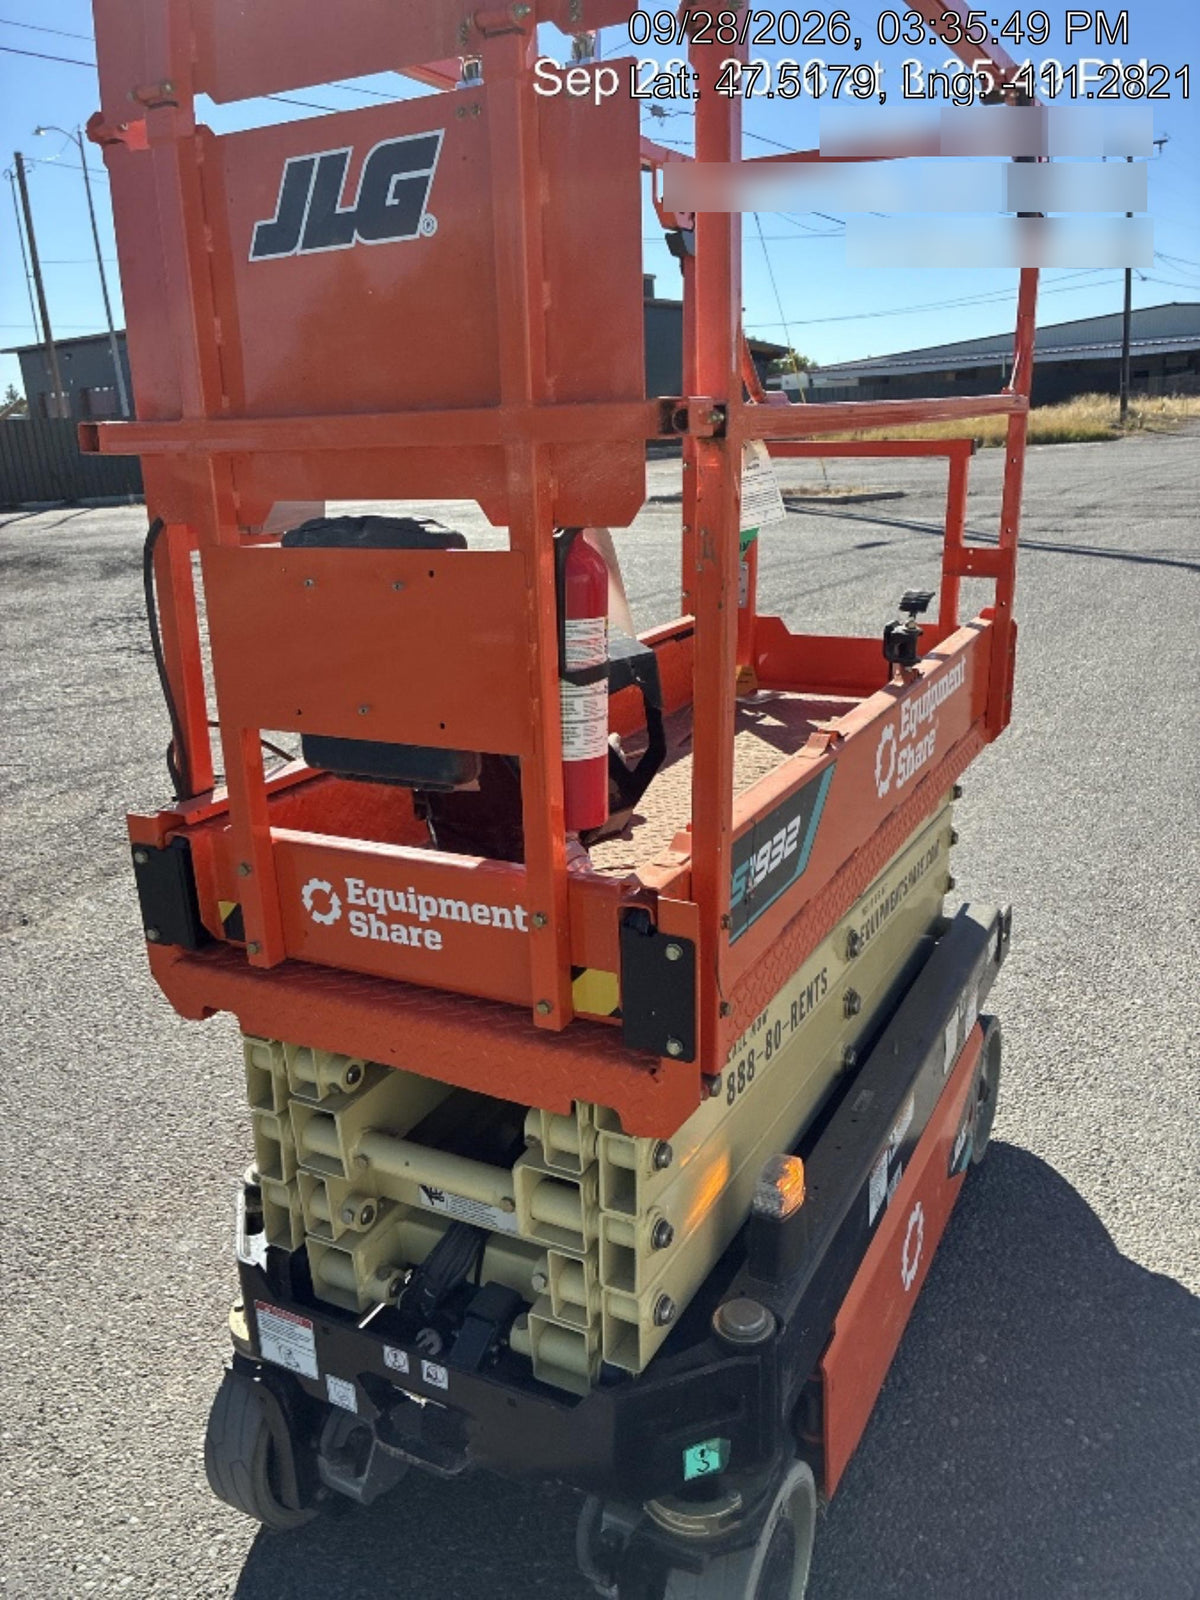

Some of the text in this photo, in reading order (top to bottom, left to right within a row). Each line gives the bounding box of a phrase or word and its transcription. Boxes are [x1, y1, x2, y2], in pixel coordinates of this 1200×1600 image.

[248, 128, 445, 262] JLG
[900, 655, 967, 742] Equipment
[896, 727, 937, 789] Share
[344, 877, 528, 932] Equipment
[349, 911, 443, 950] Share
[726, 967, 828, 1106] 888-80-RENTS
